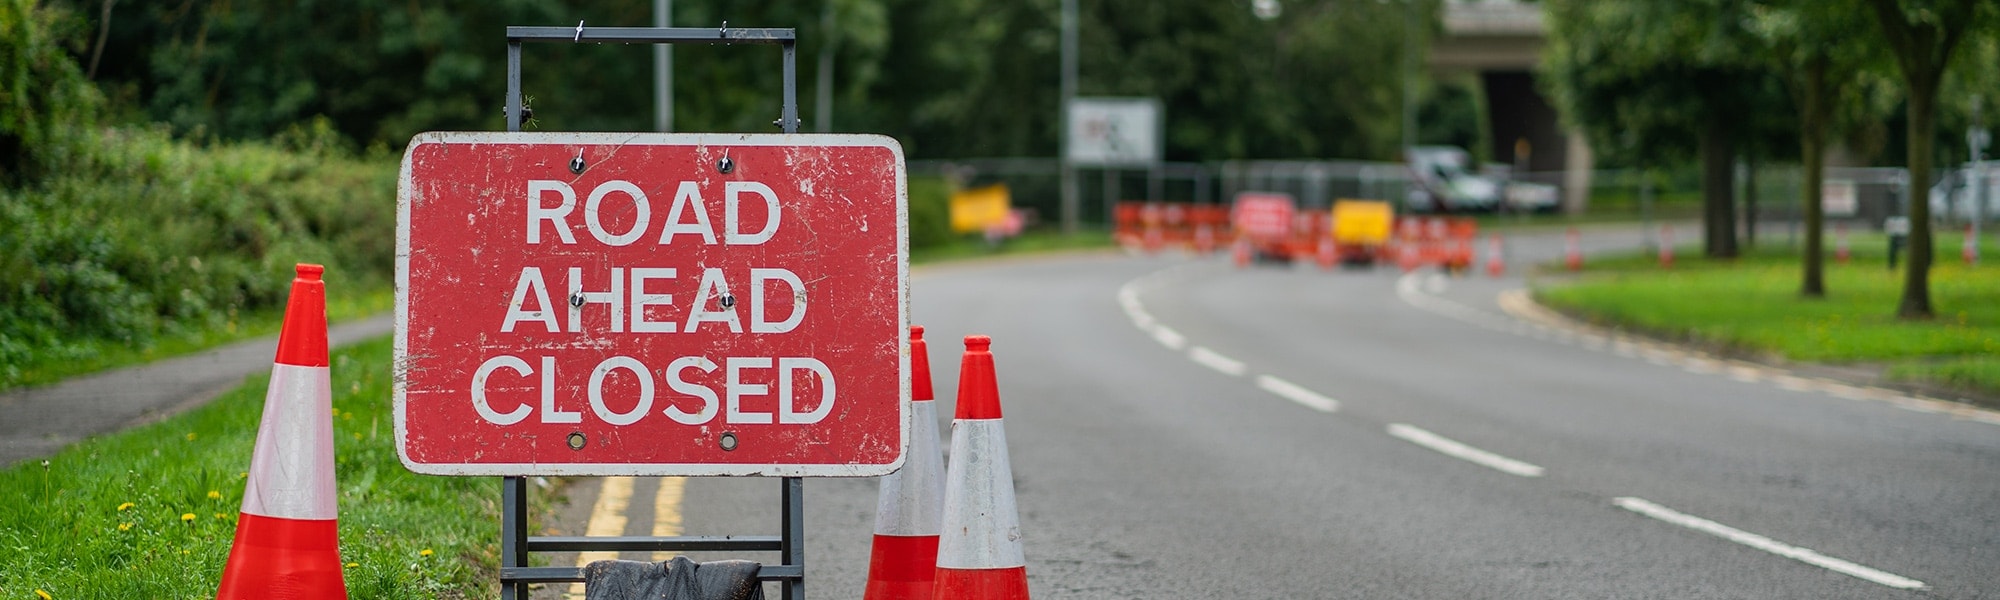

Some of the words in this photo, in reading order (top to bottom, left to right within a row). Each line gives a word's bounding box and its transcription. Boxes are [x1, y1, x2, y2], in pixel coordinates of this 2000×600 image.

[526, 180, 782, 246] ROAD
[500, 266, 808, 334] AHEAD
[471, 355, 837, 426] CLOSED
